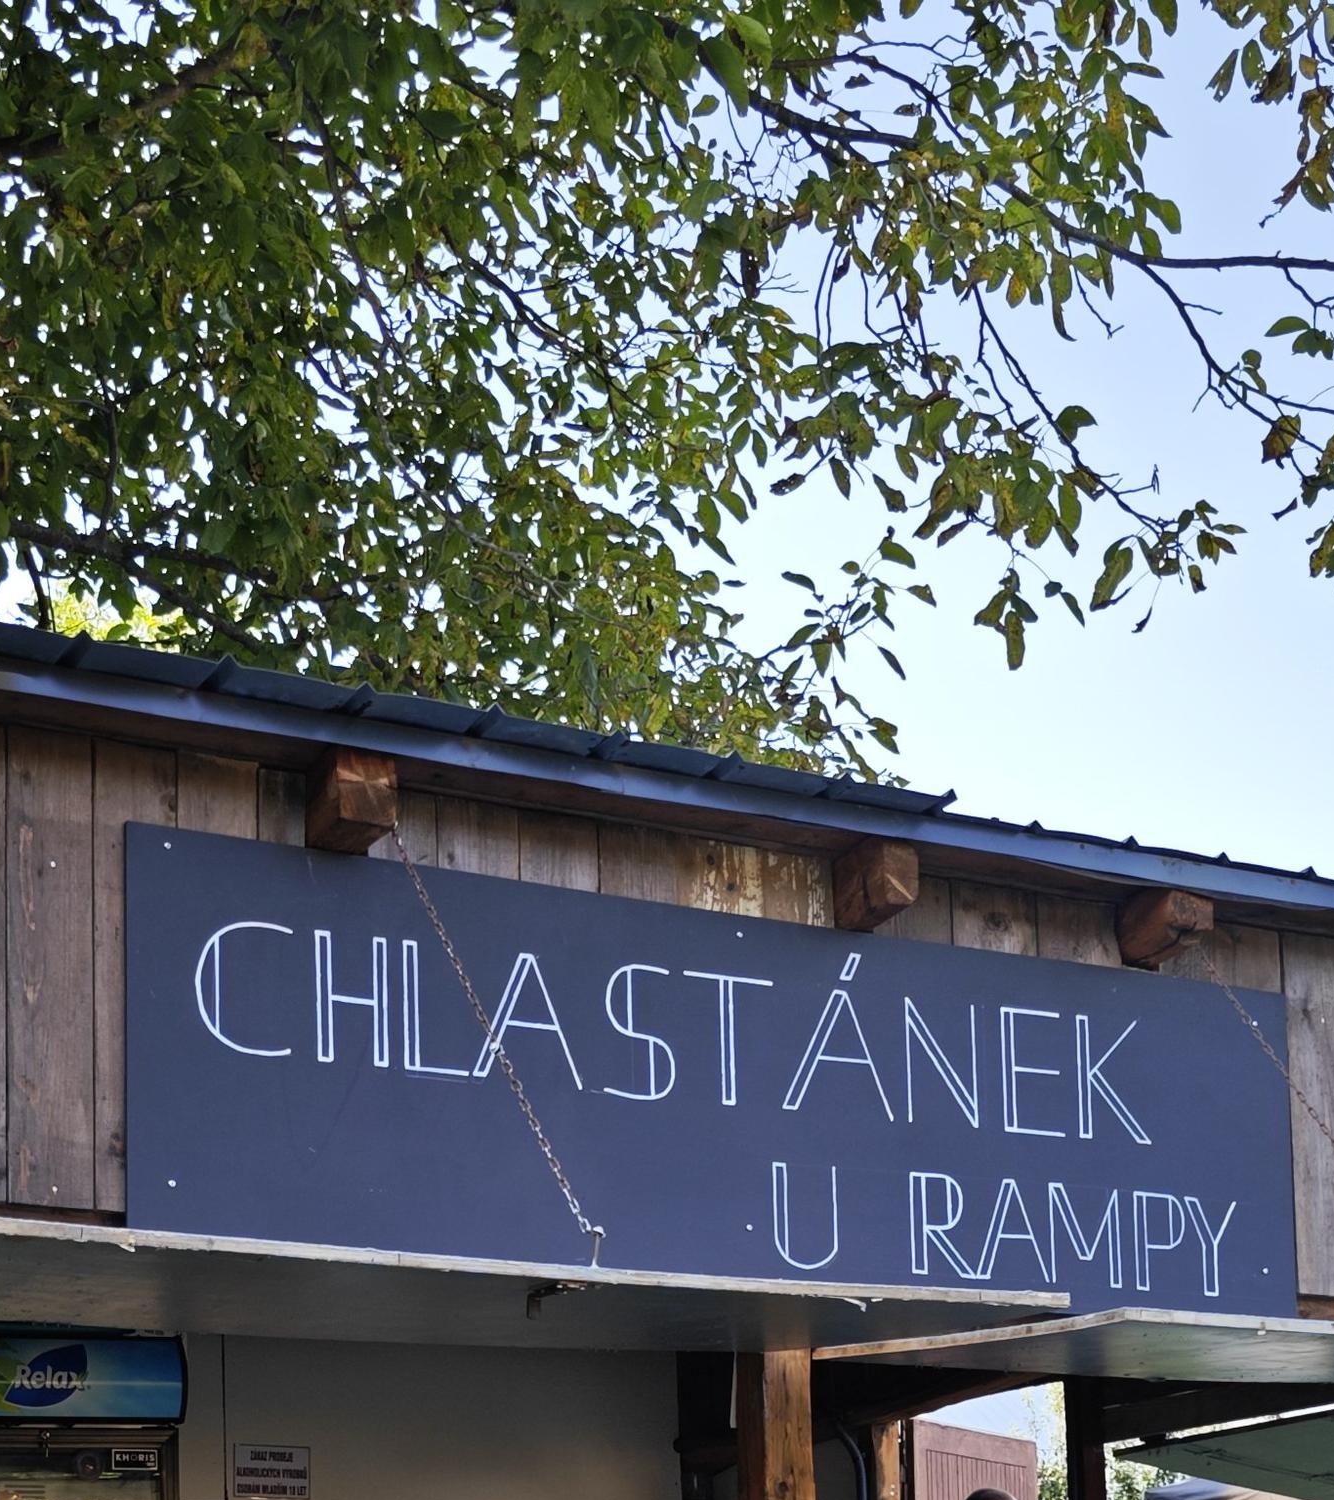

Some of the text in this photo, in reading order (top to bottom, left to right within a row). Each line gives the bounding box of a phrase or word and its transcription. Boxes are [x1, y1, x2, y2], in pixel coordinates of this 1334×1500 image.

[195, 919, 1152, 1147] CHLASTÁNEK
[771, 1161, 1237, 1297] U RAMPY
[13, 1364, 87, 1391] Relax
[115, 1453, 156, 1462] KHORIS
